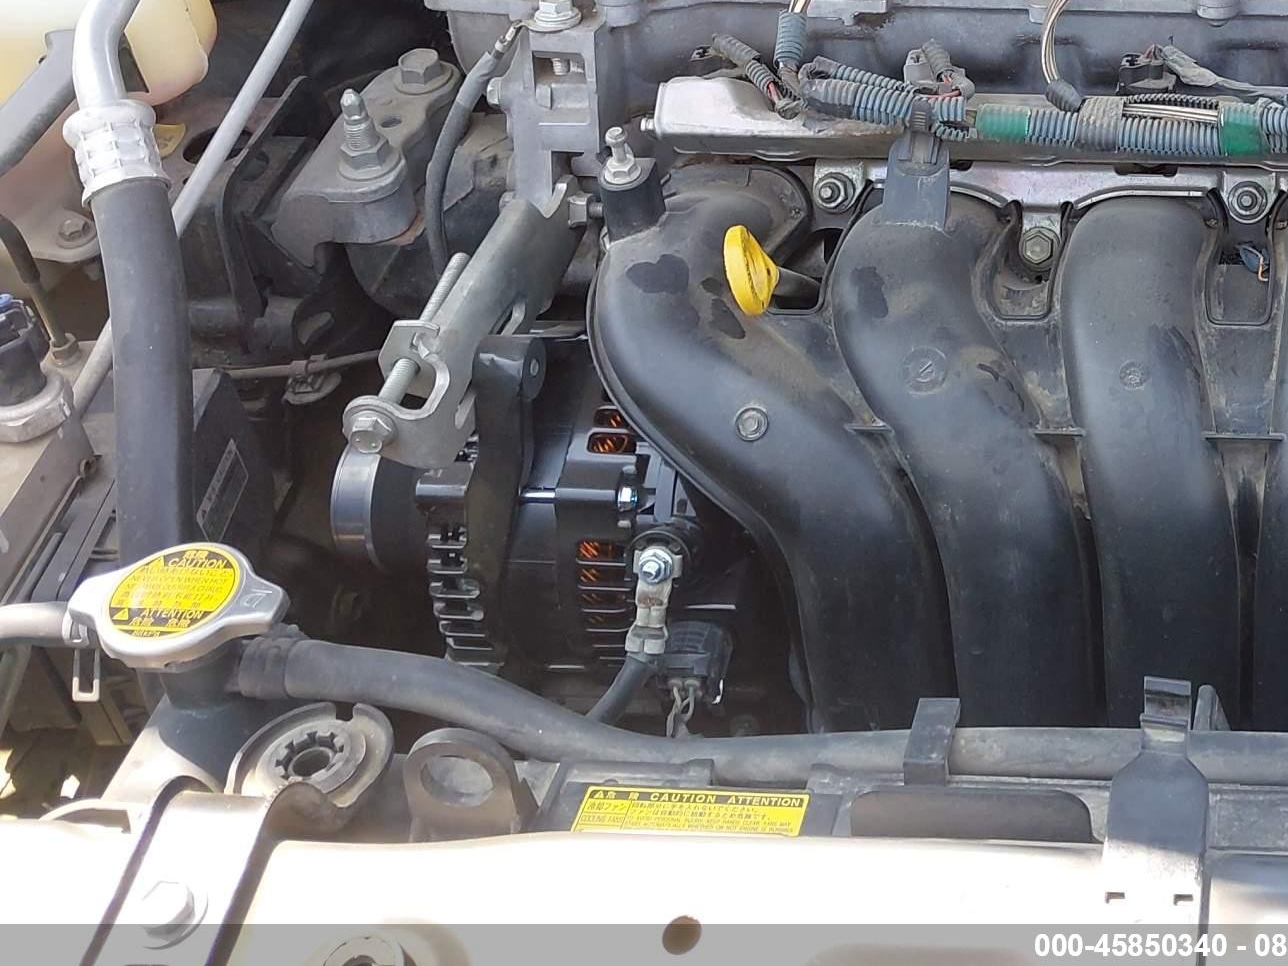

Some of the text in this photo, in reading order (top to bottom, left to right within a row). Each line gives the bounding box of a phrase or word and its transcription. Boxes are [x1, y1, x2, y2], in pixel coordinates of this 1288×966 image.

[168, 557, 227, 569] CAUTION
[141, 608, 204, 619] ATTENTION
[650, 792, 716, 803] CAUTION
[727, 795, 801, 807] ATTENTION
